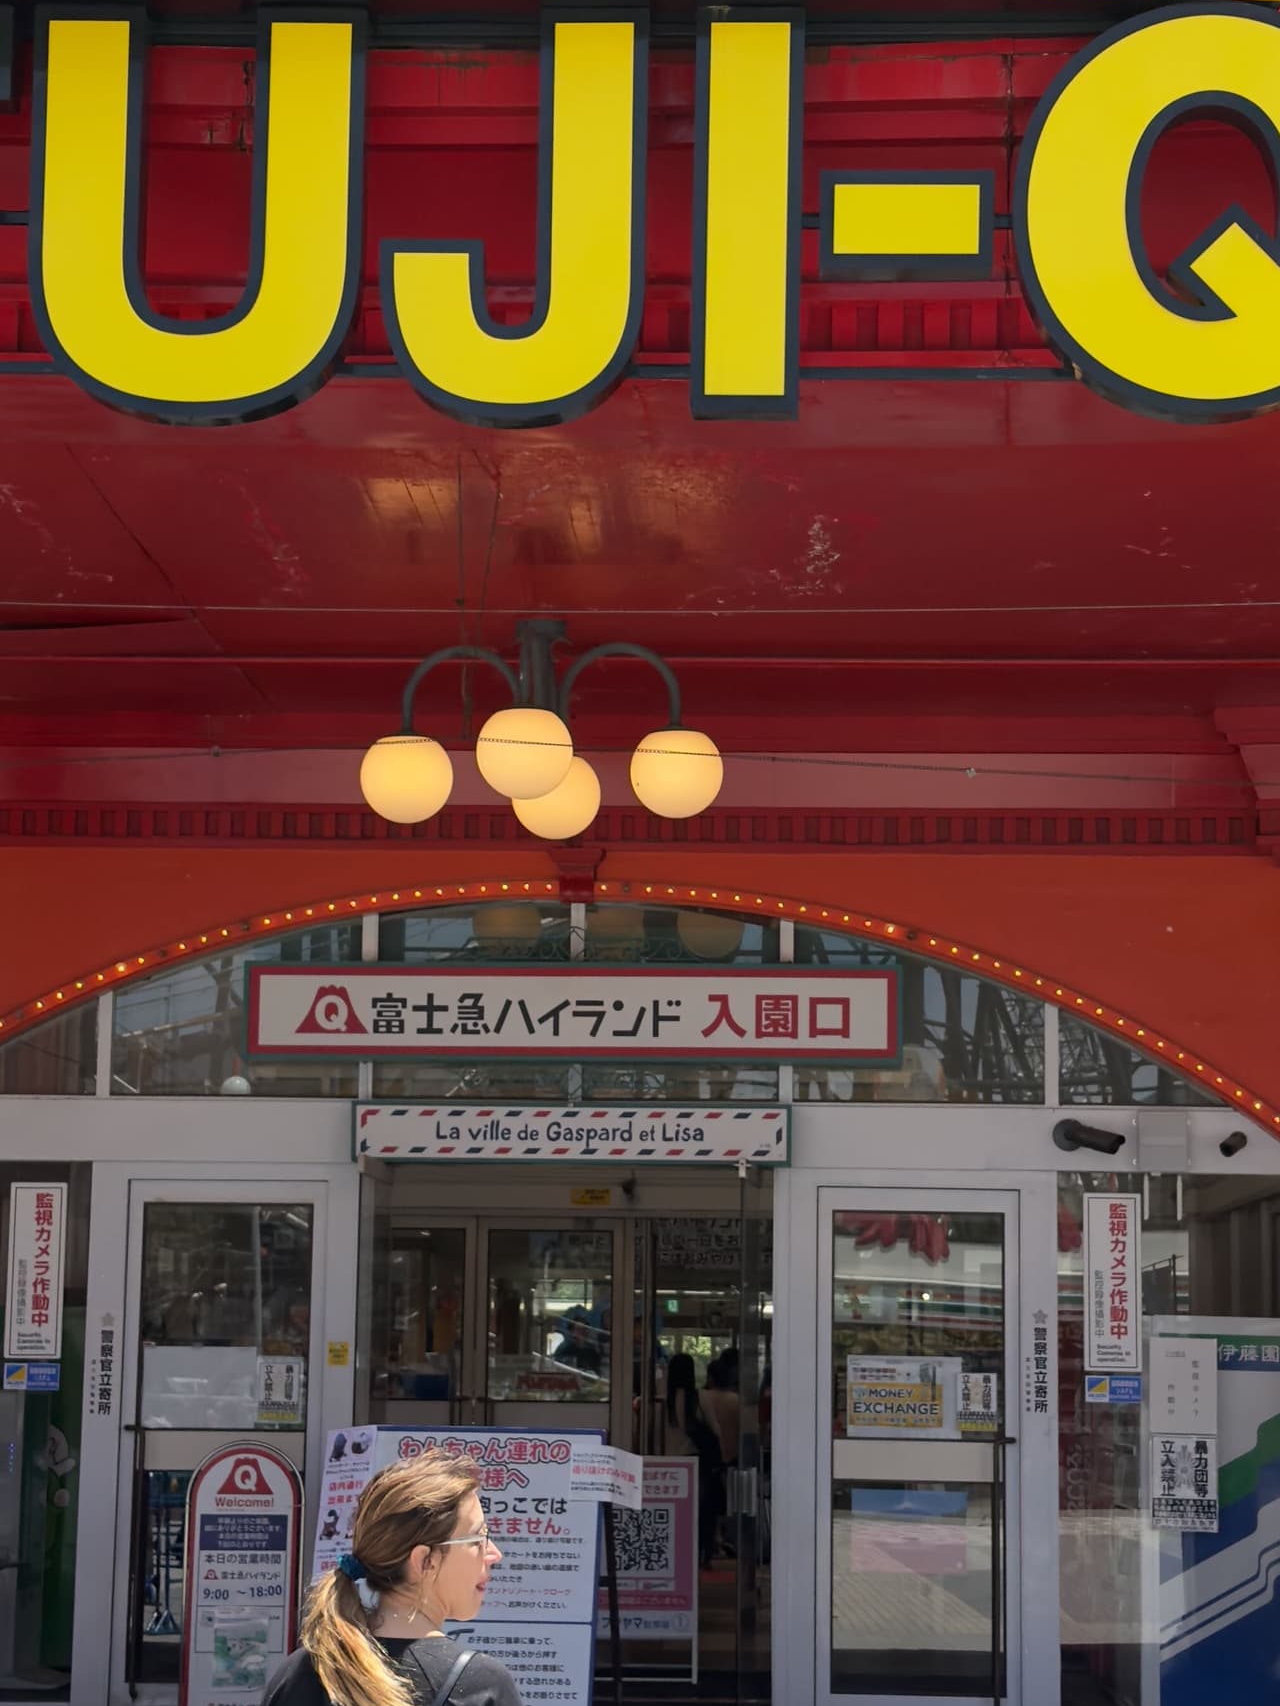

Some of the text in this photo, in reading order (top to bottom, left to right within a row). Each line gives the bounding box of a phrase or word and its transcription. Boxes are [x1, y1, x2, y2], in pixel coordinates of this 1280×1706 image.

[371, 992, 851, 1039] 富士急ハイランド 入園口
[436, 1120, 705, 1149] La ville de Gaspard et Lisa
[31, 1193, 54, 1327] 監視カメラ作動中
[1108, 1203, 1128, 1340] 監視カメラ作動中
[98, 1330, 114, 1415] 警察官立寄所
[1034, 1327, 1048, 1413] 警察官立寄所
[1218, 1345, 1280, 1362] 伊藤園
[852, 1402, 940, 1415] EXCHANGE
[869, 1388, 913, 1399] MONEY
[1160, 1440, 1176, 1497] 立入禁止
[1194, 1440, 1209, 1498] 暴力団等
[215, 1496, 274, 1508] Welcome!
[204, 1553, 282, 1565] 本日の営業時間
[203, 1588, 229, 1601] 9:00
